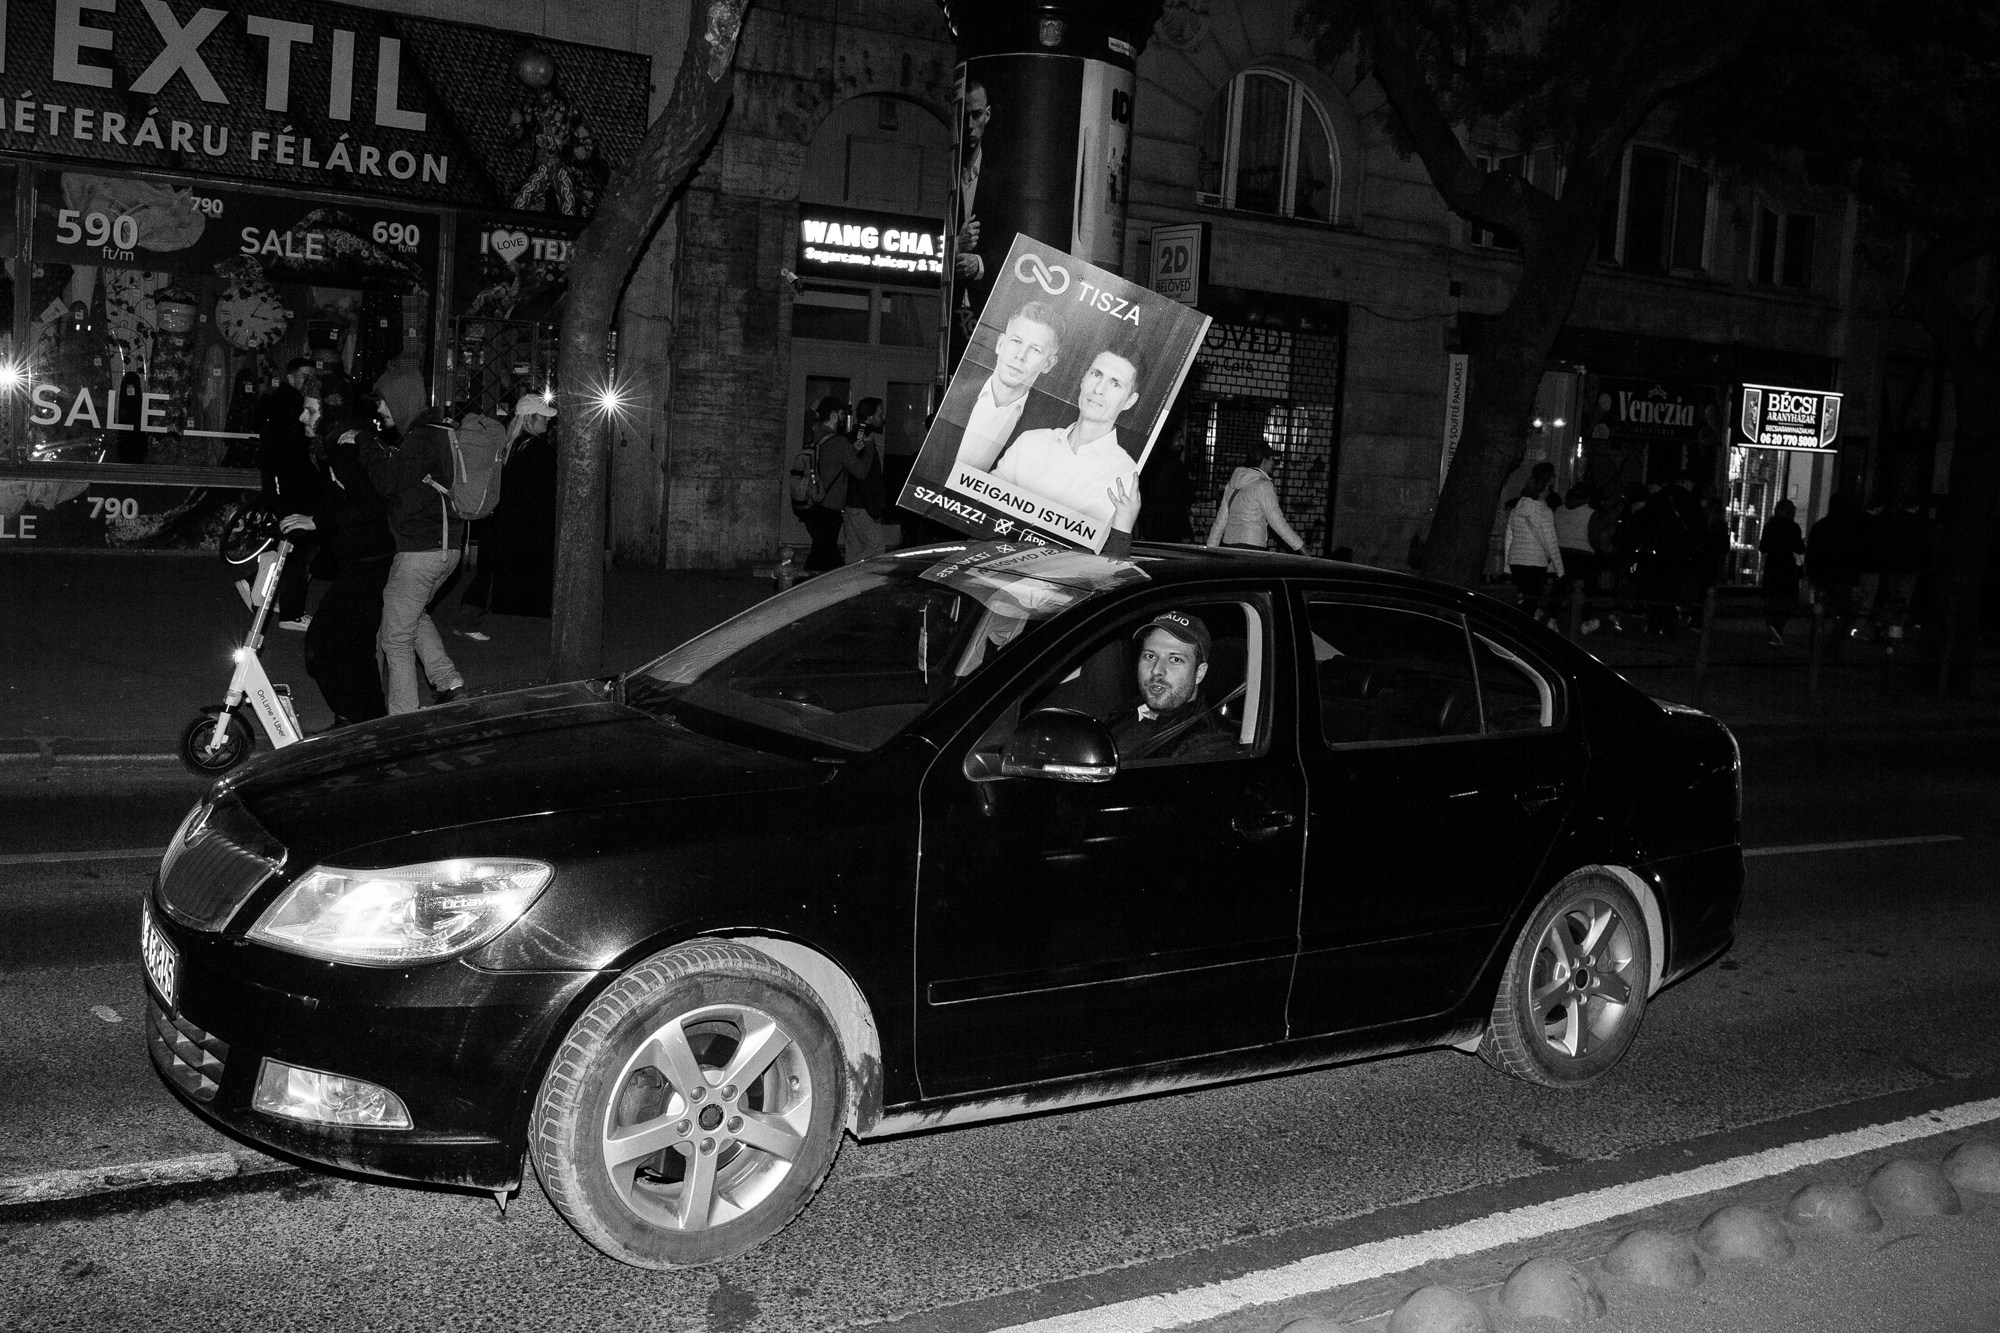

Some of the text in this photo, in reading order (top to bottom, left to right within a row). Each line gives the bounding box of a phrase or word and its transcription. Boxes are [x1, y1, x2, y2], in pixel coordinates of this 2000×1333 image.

[0, 0, 426, 131] EXTIL
[0, 90, 449, 184] ÉTERÁRU FÉLÁRON
[190, 197, 224, 215] 790
[56, 209, 139, 250] 590
[240, 227, 326, 260] SALE
[372, 221, 420, 247] 690
[480, 231, 490, 255] I
[497, 238, 524, 251] LOVE
[803, 219, 879, 250] WANG
[883, 229, 934, 256] CHA
[102, 246, 134, 261] ft/m
[917, 259, 928, 271] &
[1160, 245, 1188, 273] 2D
[1155, 280, 1191, 293] BELOVED
[1077, 281, 1141, 326] TISZA
[1452, 361, 1463, 404] PANCAKES
[29, 384, 170, 434] SALE
[1618, 390, 1695, 427] Venezia
[1767, 391, 1818, 415] BÉCSI
[1766, 411, 1816, 425] ARANYHÁZAK
[1760, 432, 1771, 445] 06
[1772, 433, 1783, 446] 20
[87, 497, 140, 519] 790
[914, 486, 987, 525] SZAVAZZ!
[959, 473, 1096, 540] WEIGAND ISTVÁN
[273, 721, 285, 737] Uber
